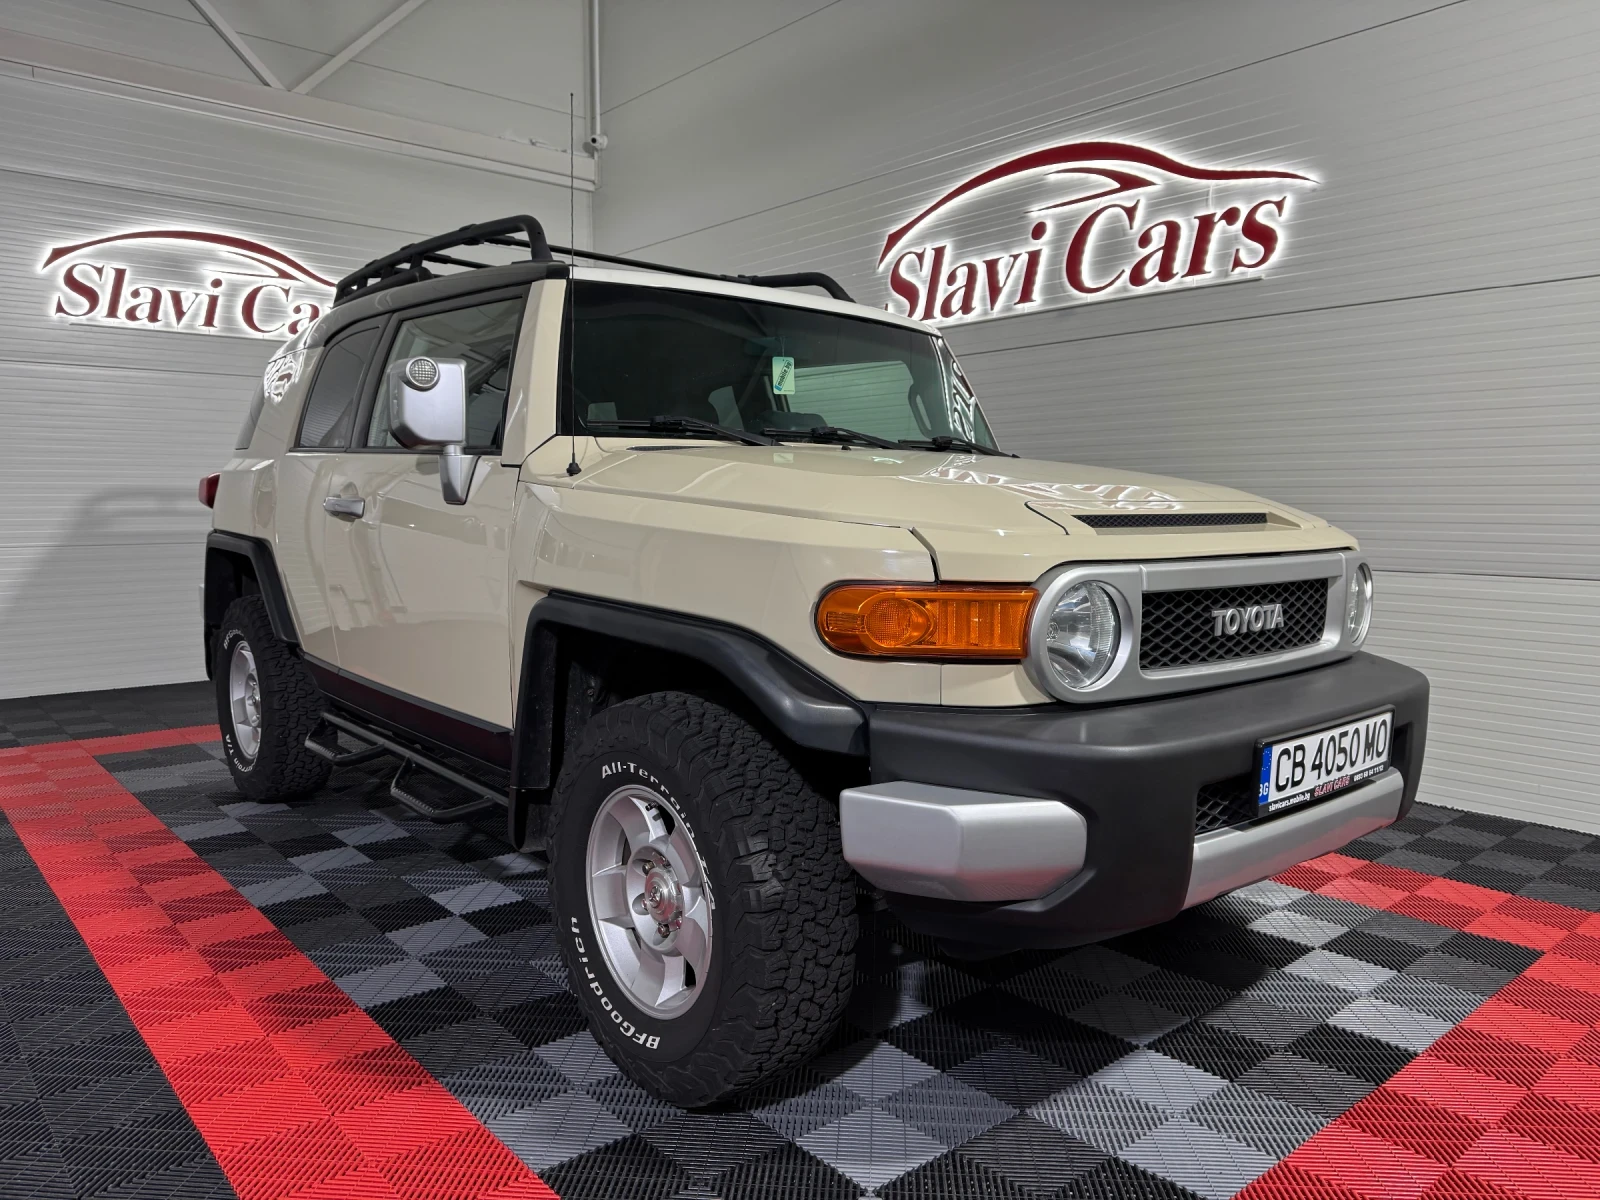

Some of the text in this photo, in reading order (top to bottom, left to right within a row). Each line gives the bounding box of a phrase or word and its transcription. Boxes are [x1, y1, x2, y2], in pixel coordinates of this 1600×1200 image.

[884, 196, 1287, 321] Slavi Cars
[55, 263, 332, 335] Slavi Ca
[1211, 604, 1284, 637] TOYOTA
[1275, 719, 1388, 793] CB 4050 MO
[1313, 776, 1350, 797] SLAVI CARS
[602, 761, 695, 838] All-Terrain
[571, 916, 661, 1050] BFGoodrich
